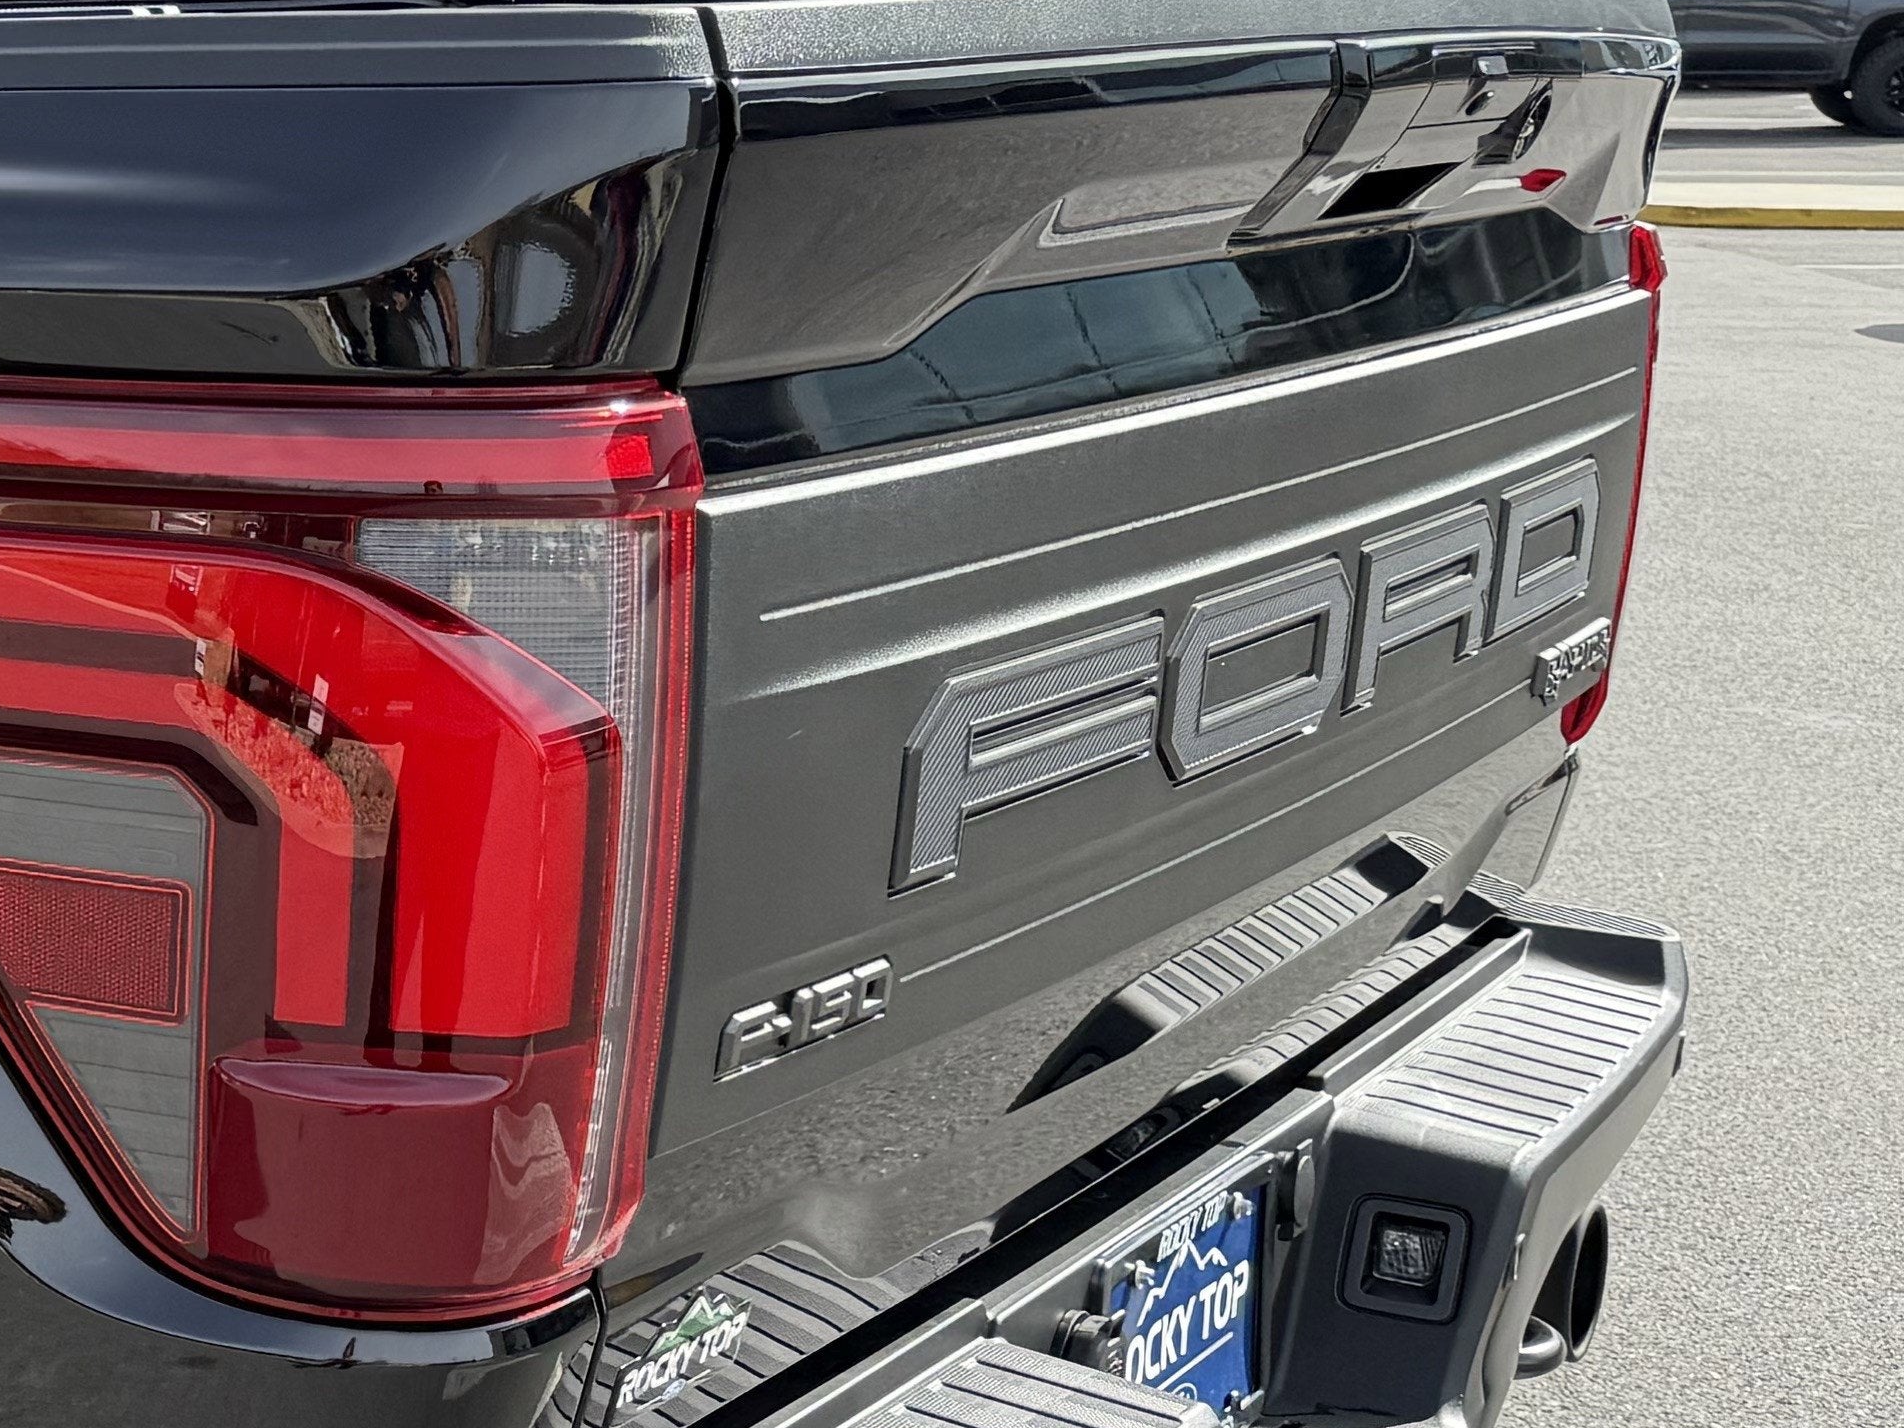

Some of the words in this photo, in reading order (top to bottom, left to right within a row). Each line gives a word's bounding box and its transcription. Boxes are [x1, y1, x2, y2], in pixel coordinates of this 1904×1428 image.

[887, 455, 1602, 898] FORD
[712, 953, 894, 1083] F-150
[615, 1336, 700, 1410] ROCKY
[698, 1311, 748, 1365] TOP
[1124, 1295, 1197, 1385] OCKY
[1198, 1259, 1250, 1340] TOP
